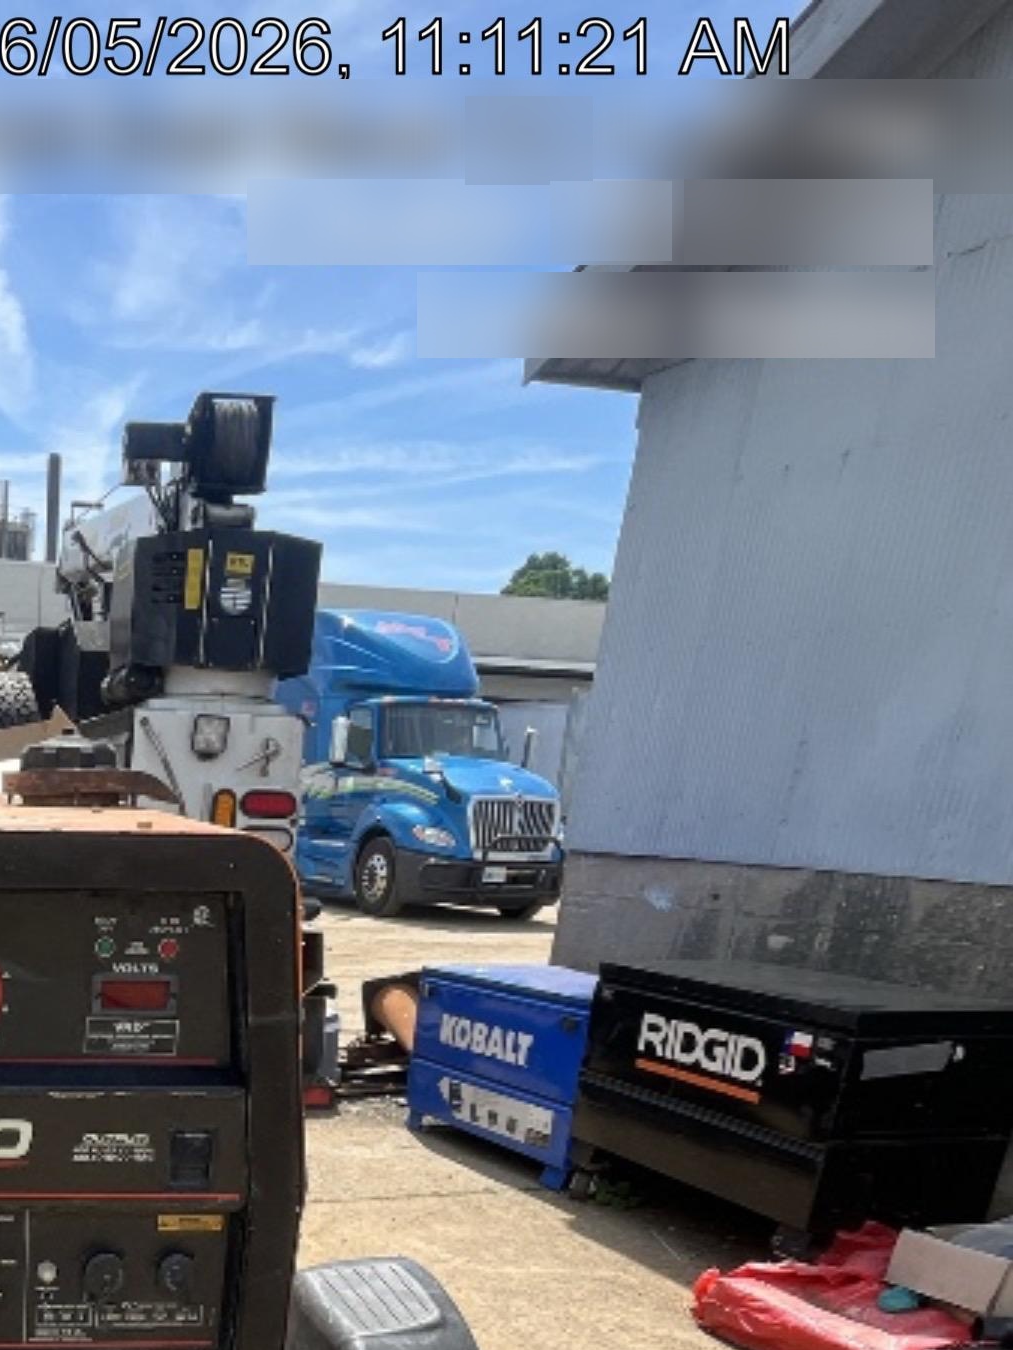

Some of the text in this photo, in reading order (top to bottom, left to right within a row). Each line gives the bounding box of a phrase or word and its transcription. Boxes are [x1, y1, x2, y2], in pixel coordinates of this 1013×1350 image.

[112, 961, 160, 974] VOLTS
[439, 1013, 534, 1068] KOBALT
[638, 1012, 767, 1082] RIDGID
